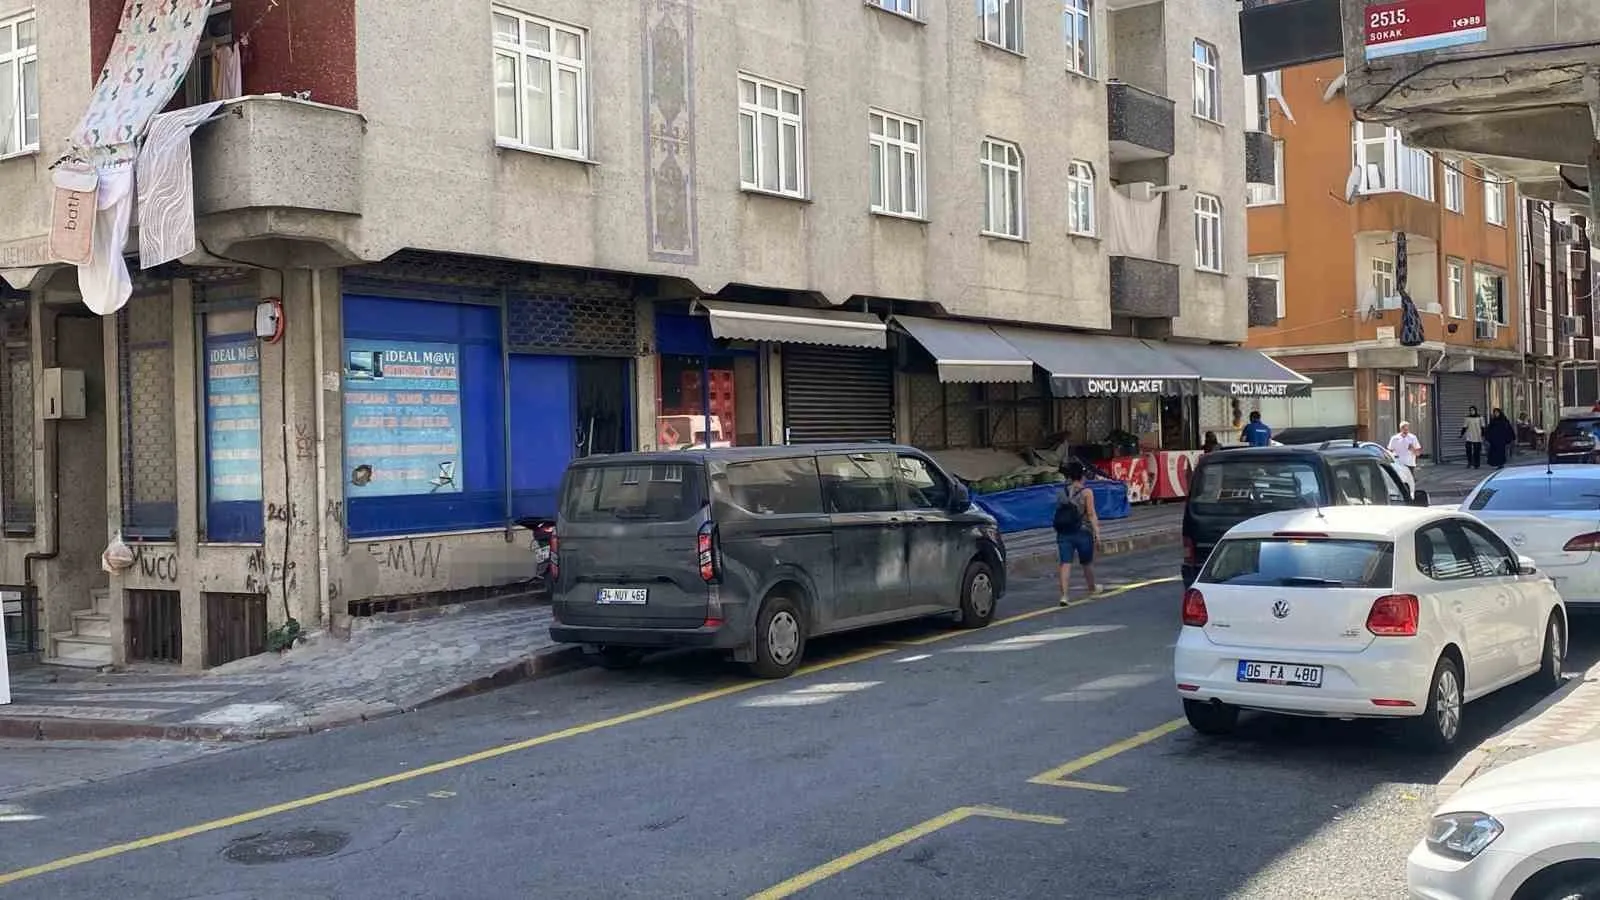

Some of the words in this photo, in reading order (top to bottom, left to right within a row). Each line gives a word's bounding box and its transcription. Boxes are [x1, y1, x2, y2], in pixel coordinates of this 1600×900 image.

[1371, 9, 1410, 28] 2515.
[1370, 29, 1402, 41] SOKAK
[64, 190, 80, 231] bath
[1120, 379, 1163, 393] MARKET
[1255, 383, 1288, 395] MARKET
[1246, 663, 1261, 677] 06
[1269, 665, 1284, 679] FA
[1294, 667, 1318, 682] 480
